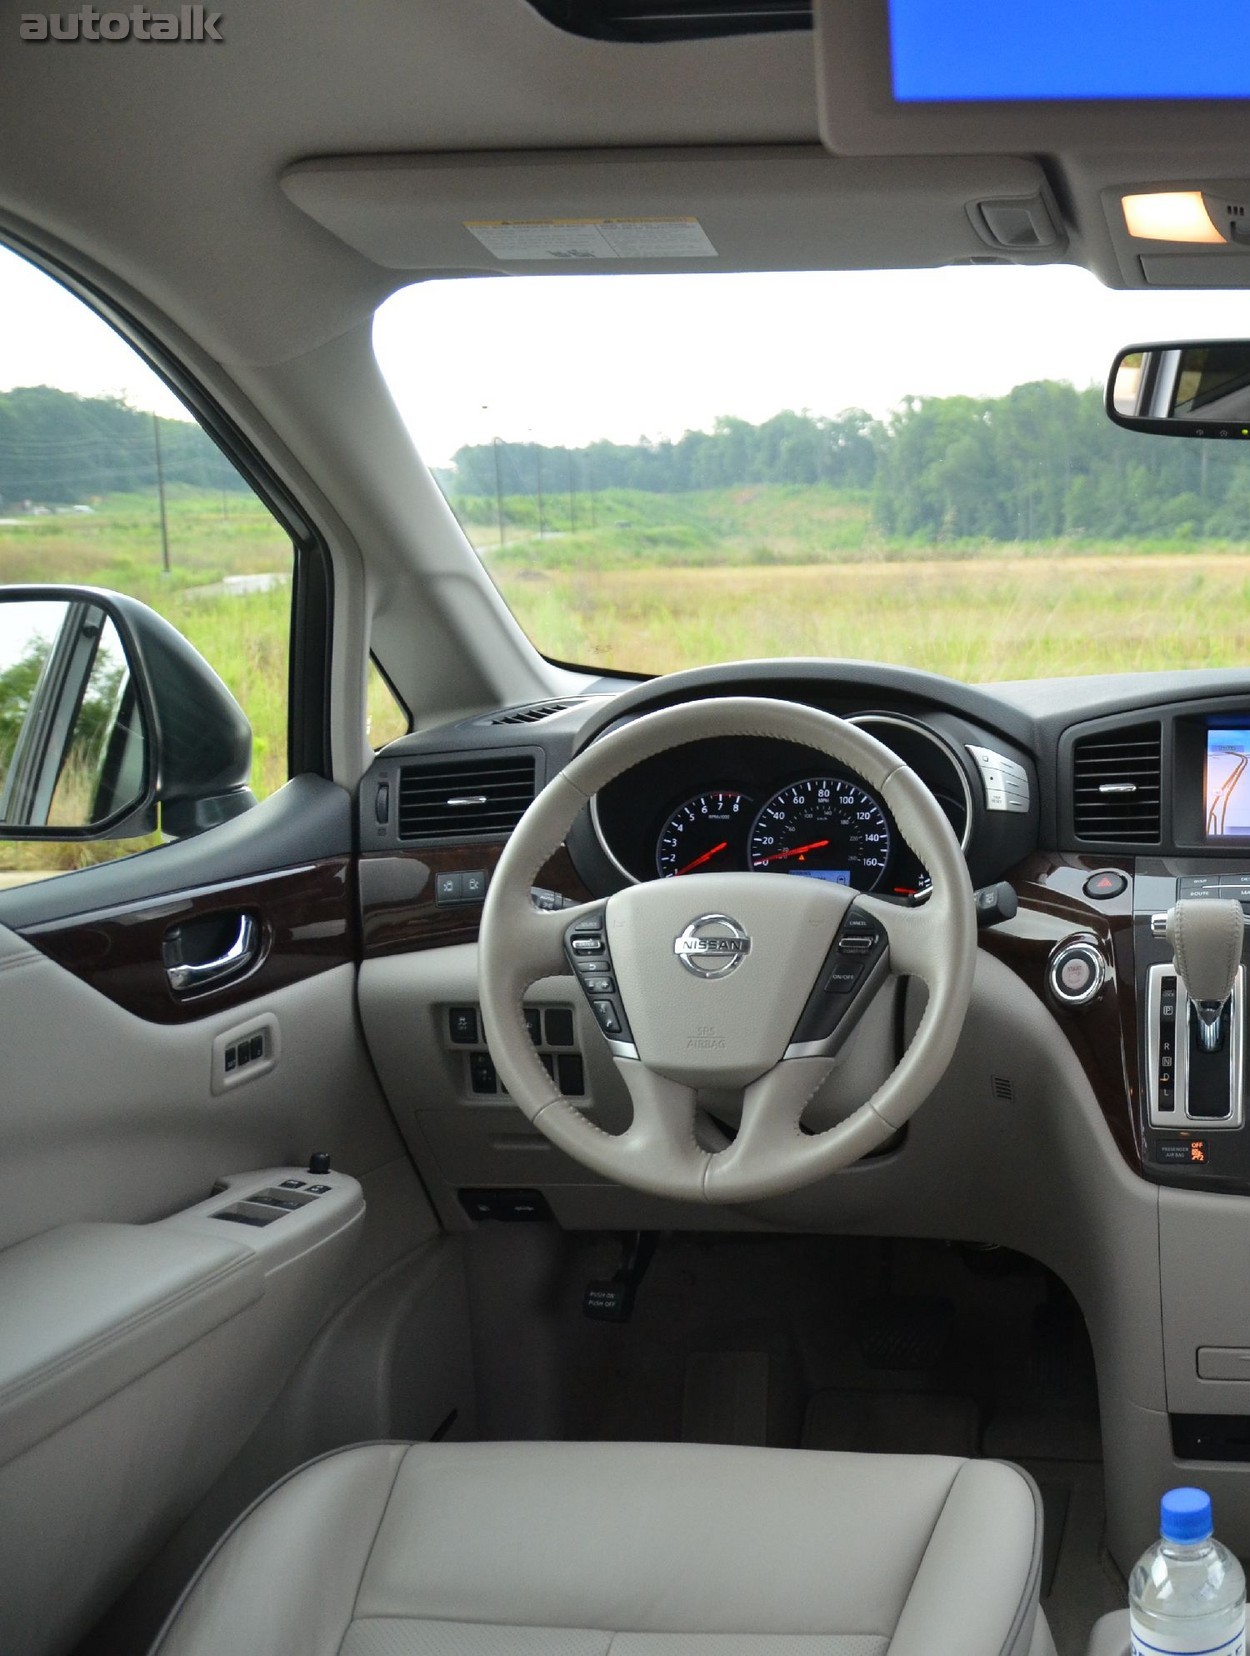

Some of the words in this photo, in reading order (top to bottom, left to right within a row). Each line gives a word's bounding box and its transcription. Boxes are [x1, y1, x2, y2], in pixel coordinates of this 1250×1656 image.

[818, 789, 830, 798] 80
[840, 796, 854, 804] 100
[701, 806, 708, 814] 6
[717, 802, 723, 811] 7
[732, 804, 739, 812] 8
[773, 812, 785, 820] 40
[856, 812, 871, 820] 120
[677, 824, 684, 832] 4
[762, 837, 774, 845] 20
[865, 834, 879, 842] 140
[671, 839, 678, 847] 3
[670, 854, 676, 862] 2
[863, 858, 878, 866] 160
[683, 940, 743, 950] NISSAN
[1164, 1042, 1170, 1051] R
[1163, 1073, 1170, 1081] D
[1163, 1088, 1169, 1096] L
